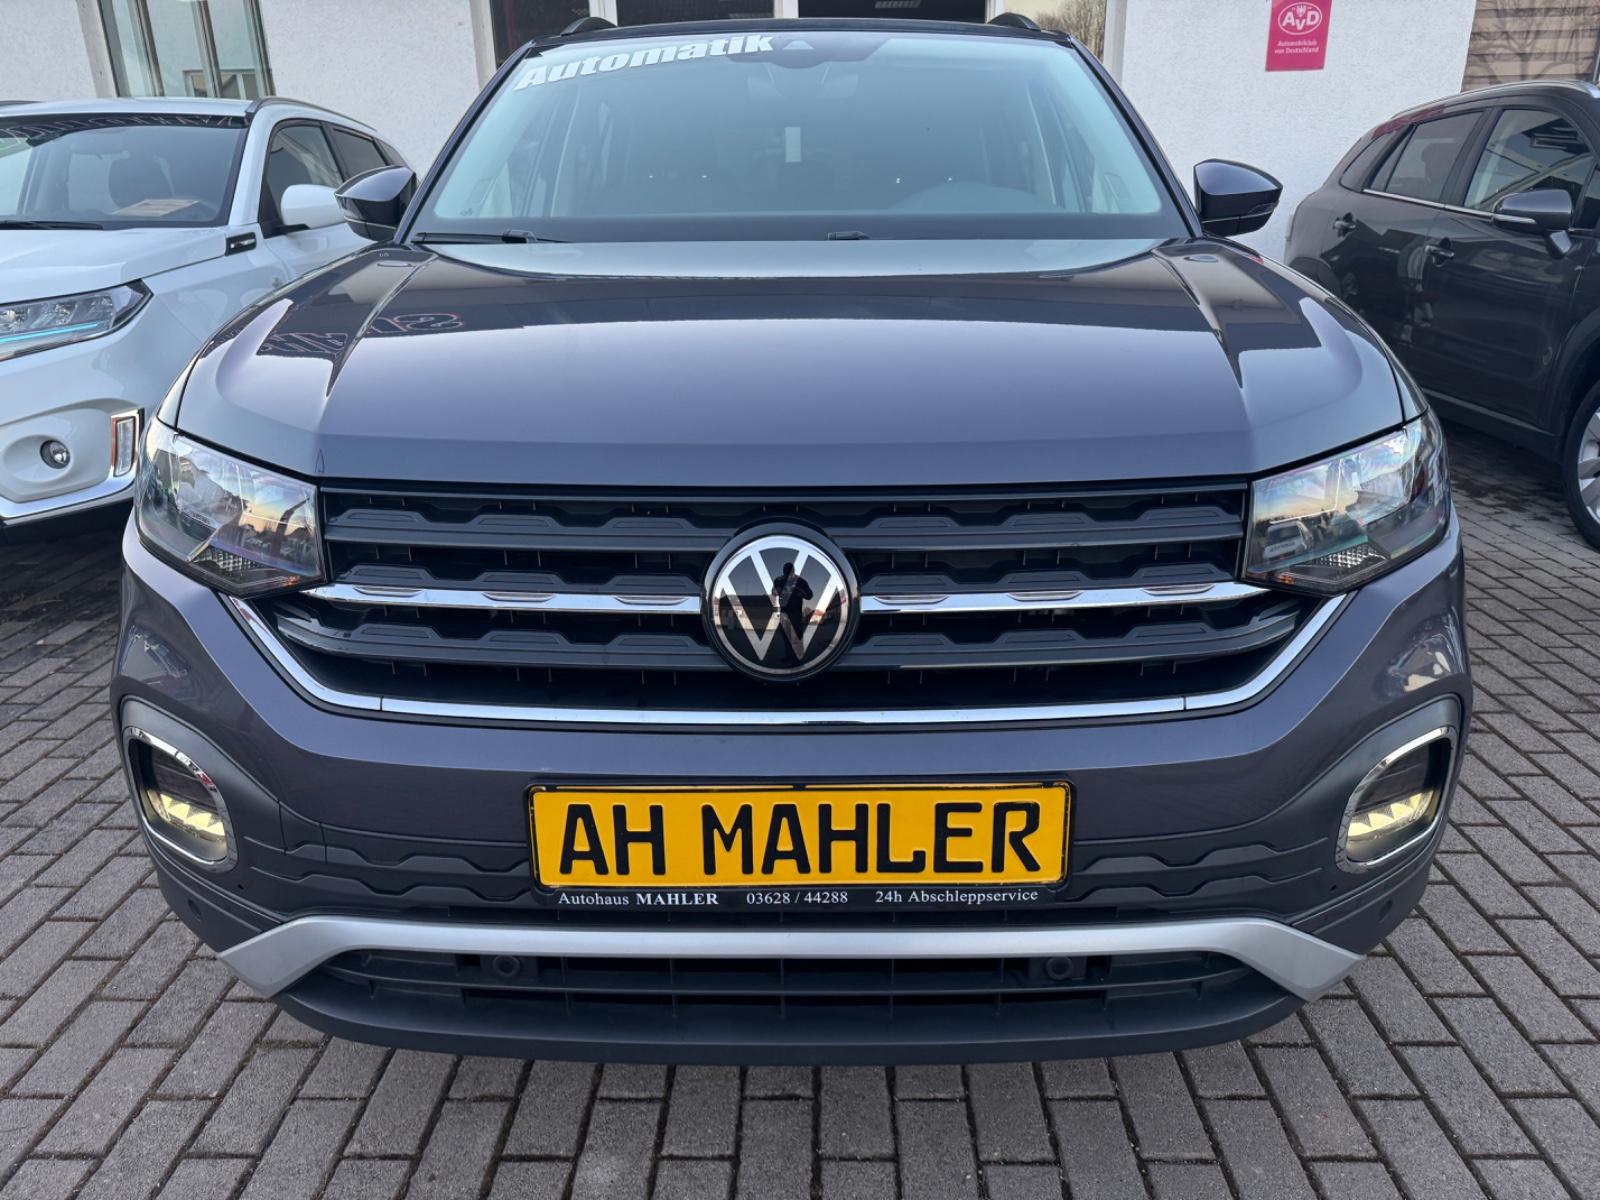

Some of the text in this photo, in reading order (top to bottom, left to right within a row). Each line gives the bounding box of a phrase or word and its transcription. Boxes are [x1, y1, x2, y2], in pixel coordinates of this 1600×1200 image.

[513, 35, 774, 91] Automatik
[559, 802, 1042, 876] AH MAHLER
[558, 892, 630, 905] Autohaus
[636, 892, 719, 905] MAHLER
[746, 892, 791, 904] 03628
[803, 891, 848, 904] 44288
[875, 890, 902, 903] 24h
[908, 889, 1039, 905] Abschleppservice
